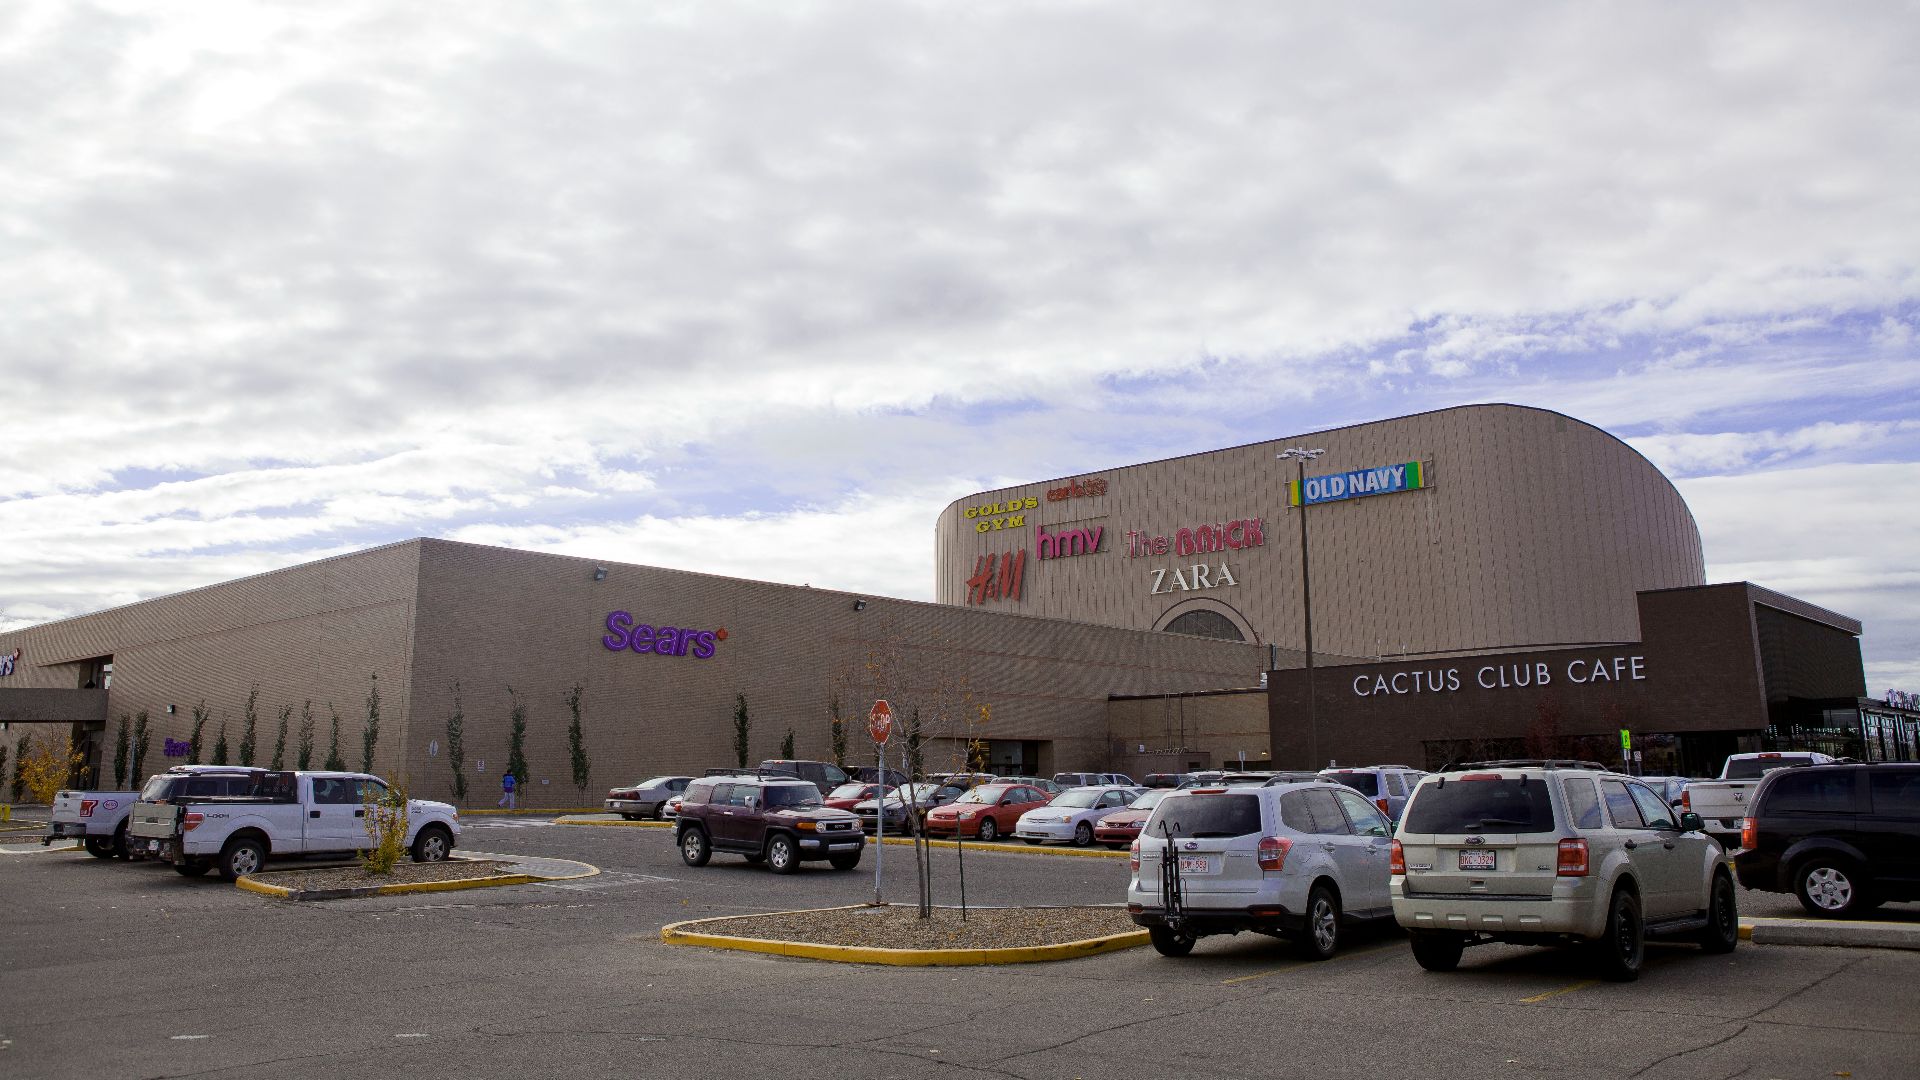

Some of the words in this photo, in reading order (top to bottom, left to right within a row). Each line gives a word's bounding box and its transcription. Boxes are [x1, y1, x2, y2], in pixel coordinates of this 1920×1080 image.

[1306, 477, 1345, 500] OLD
[1349, 466, 1404, 494] NAVY
[964, 496, 1038, 519] GOLD'S
[976, 515, 1025, 533] GYM
[1036, 524, 1103, 560] hmv
[1126, 528, 1168, 558] The
[966, 548, 1024, 605] H&M
[1150, 561, 1239, 595] ZARA
[602, 610, 717, 658] Sears
[1353, 668, 1460, 696] CACTUS
[1477, 663, 1551, 689] CLUB
[1567, 656, 1646, 683] CAFE
